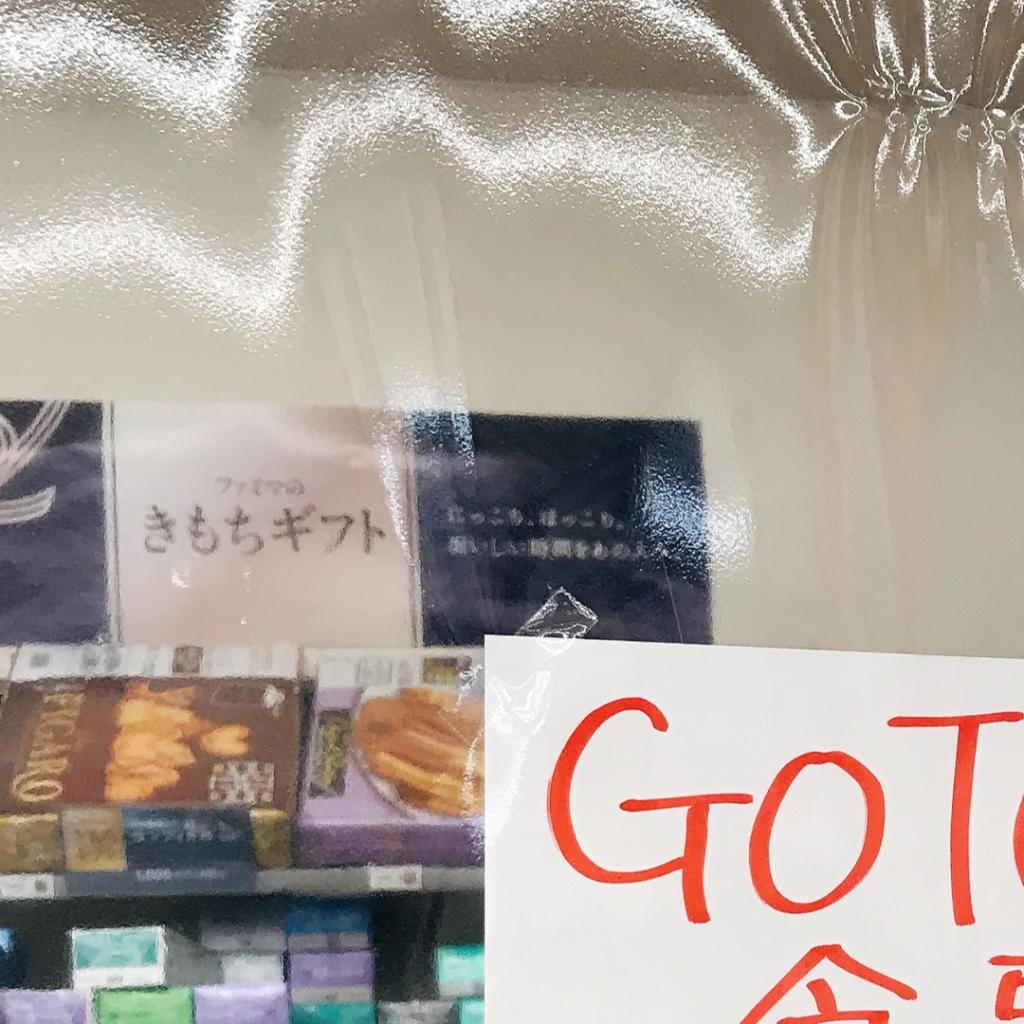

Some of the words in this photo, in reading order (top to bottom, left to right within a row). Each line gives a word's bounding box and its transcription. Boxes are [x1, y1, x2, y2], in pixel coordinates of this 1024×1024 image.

[143, 502, 387, 556] きもちギフト
